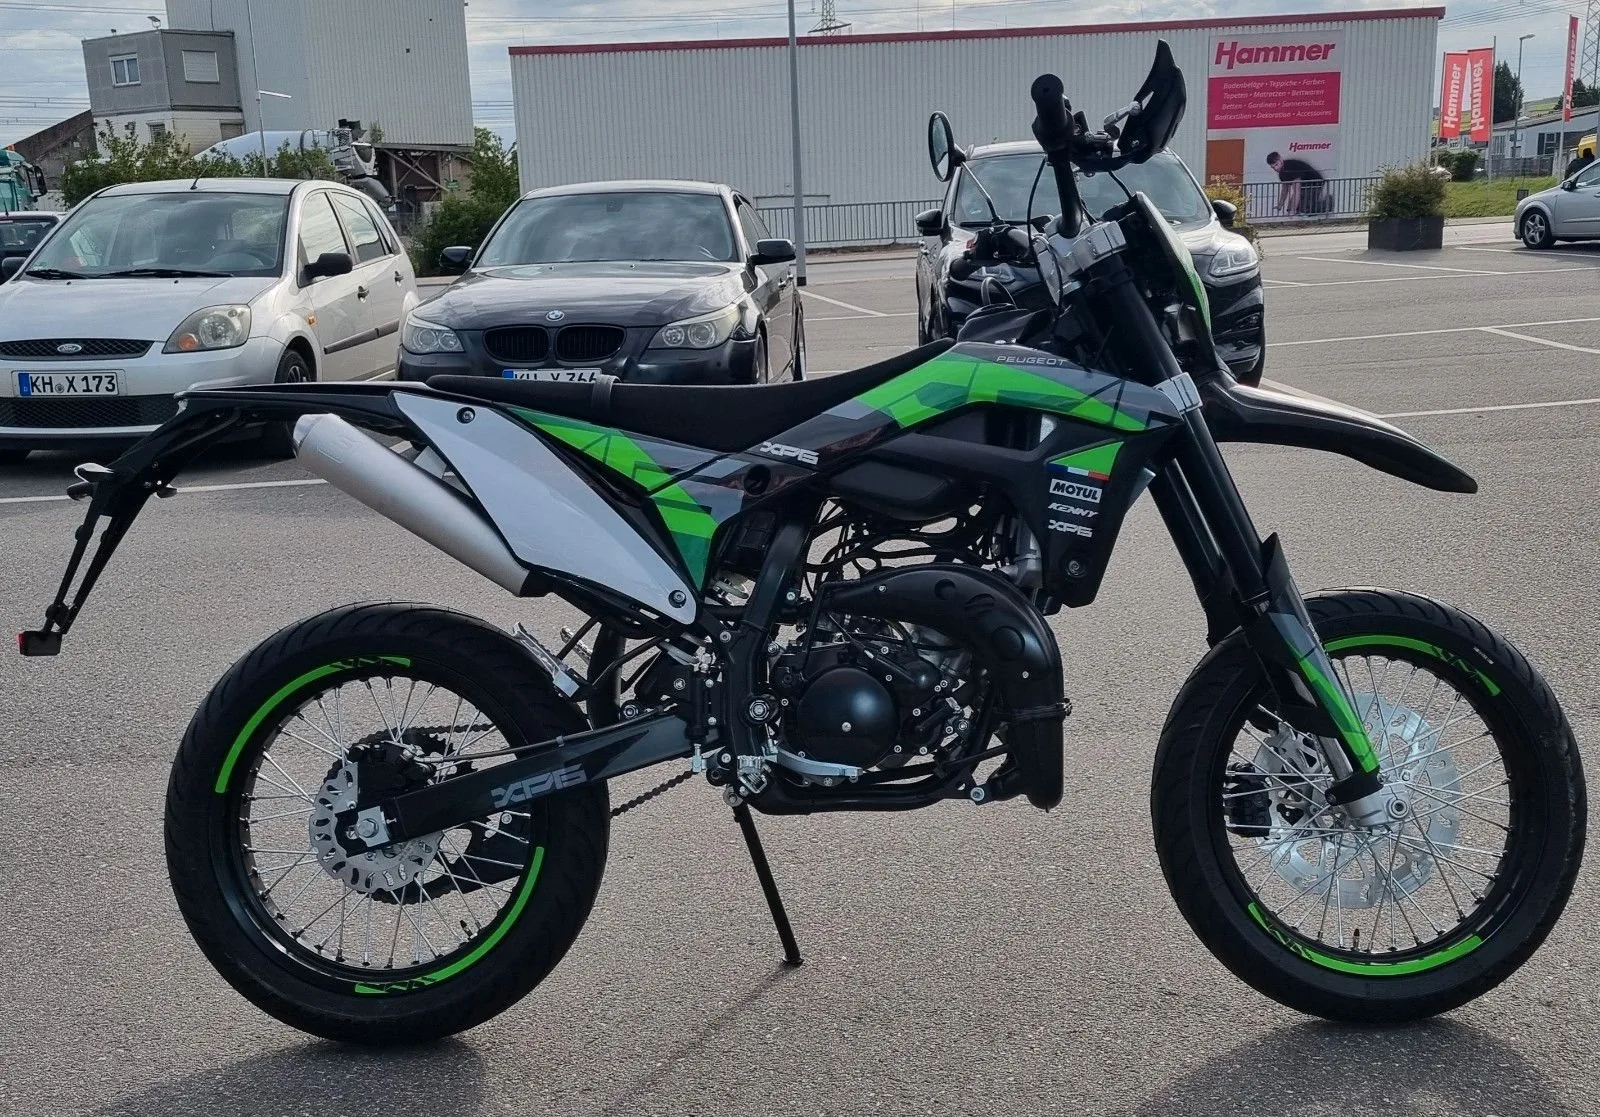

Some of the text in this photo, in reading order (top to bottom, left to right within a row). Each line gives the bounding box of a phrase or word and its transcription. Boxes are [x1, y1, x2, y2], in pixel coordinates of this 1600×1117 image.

[1215, 42, 1336, 70] Hammer
[1270, 80, 1297, 88] Teppiche
[1223, 92, 1248, 100] Tapeten
[1443, 63, 1461, 128] Hammer
[1471, 59, 1485, 131] Hammer
[1289, 142, 1332, 152] Hammer
[996, 355, 1067, 366] PEUGEOT
[30, 376, 54, 393] KH
[65, 376, 77, 393] X
[81, 375, 116, 393] 173
[1052, 481, 1099, 501] MOTUL
[1048, 502, 1100, 518] KENNY
